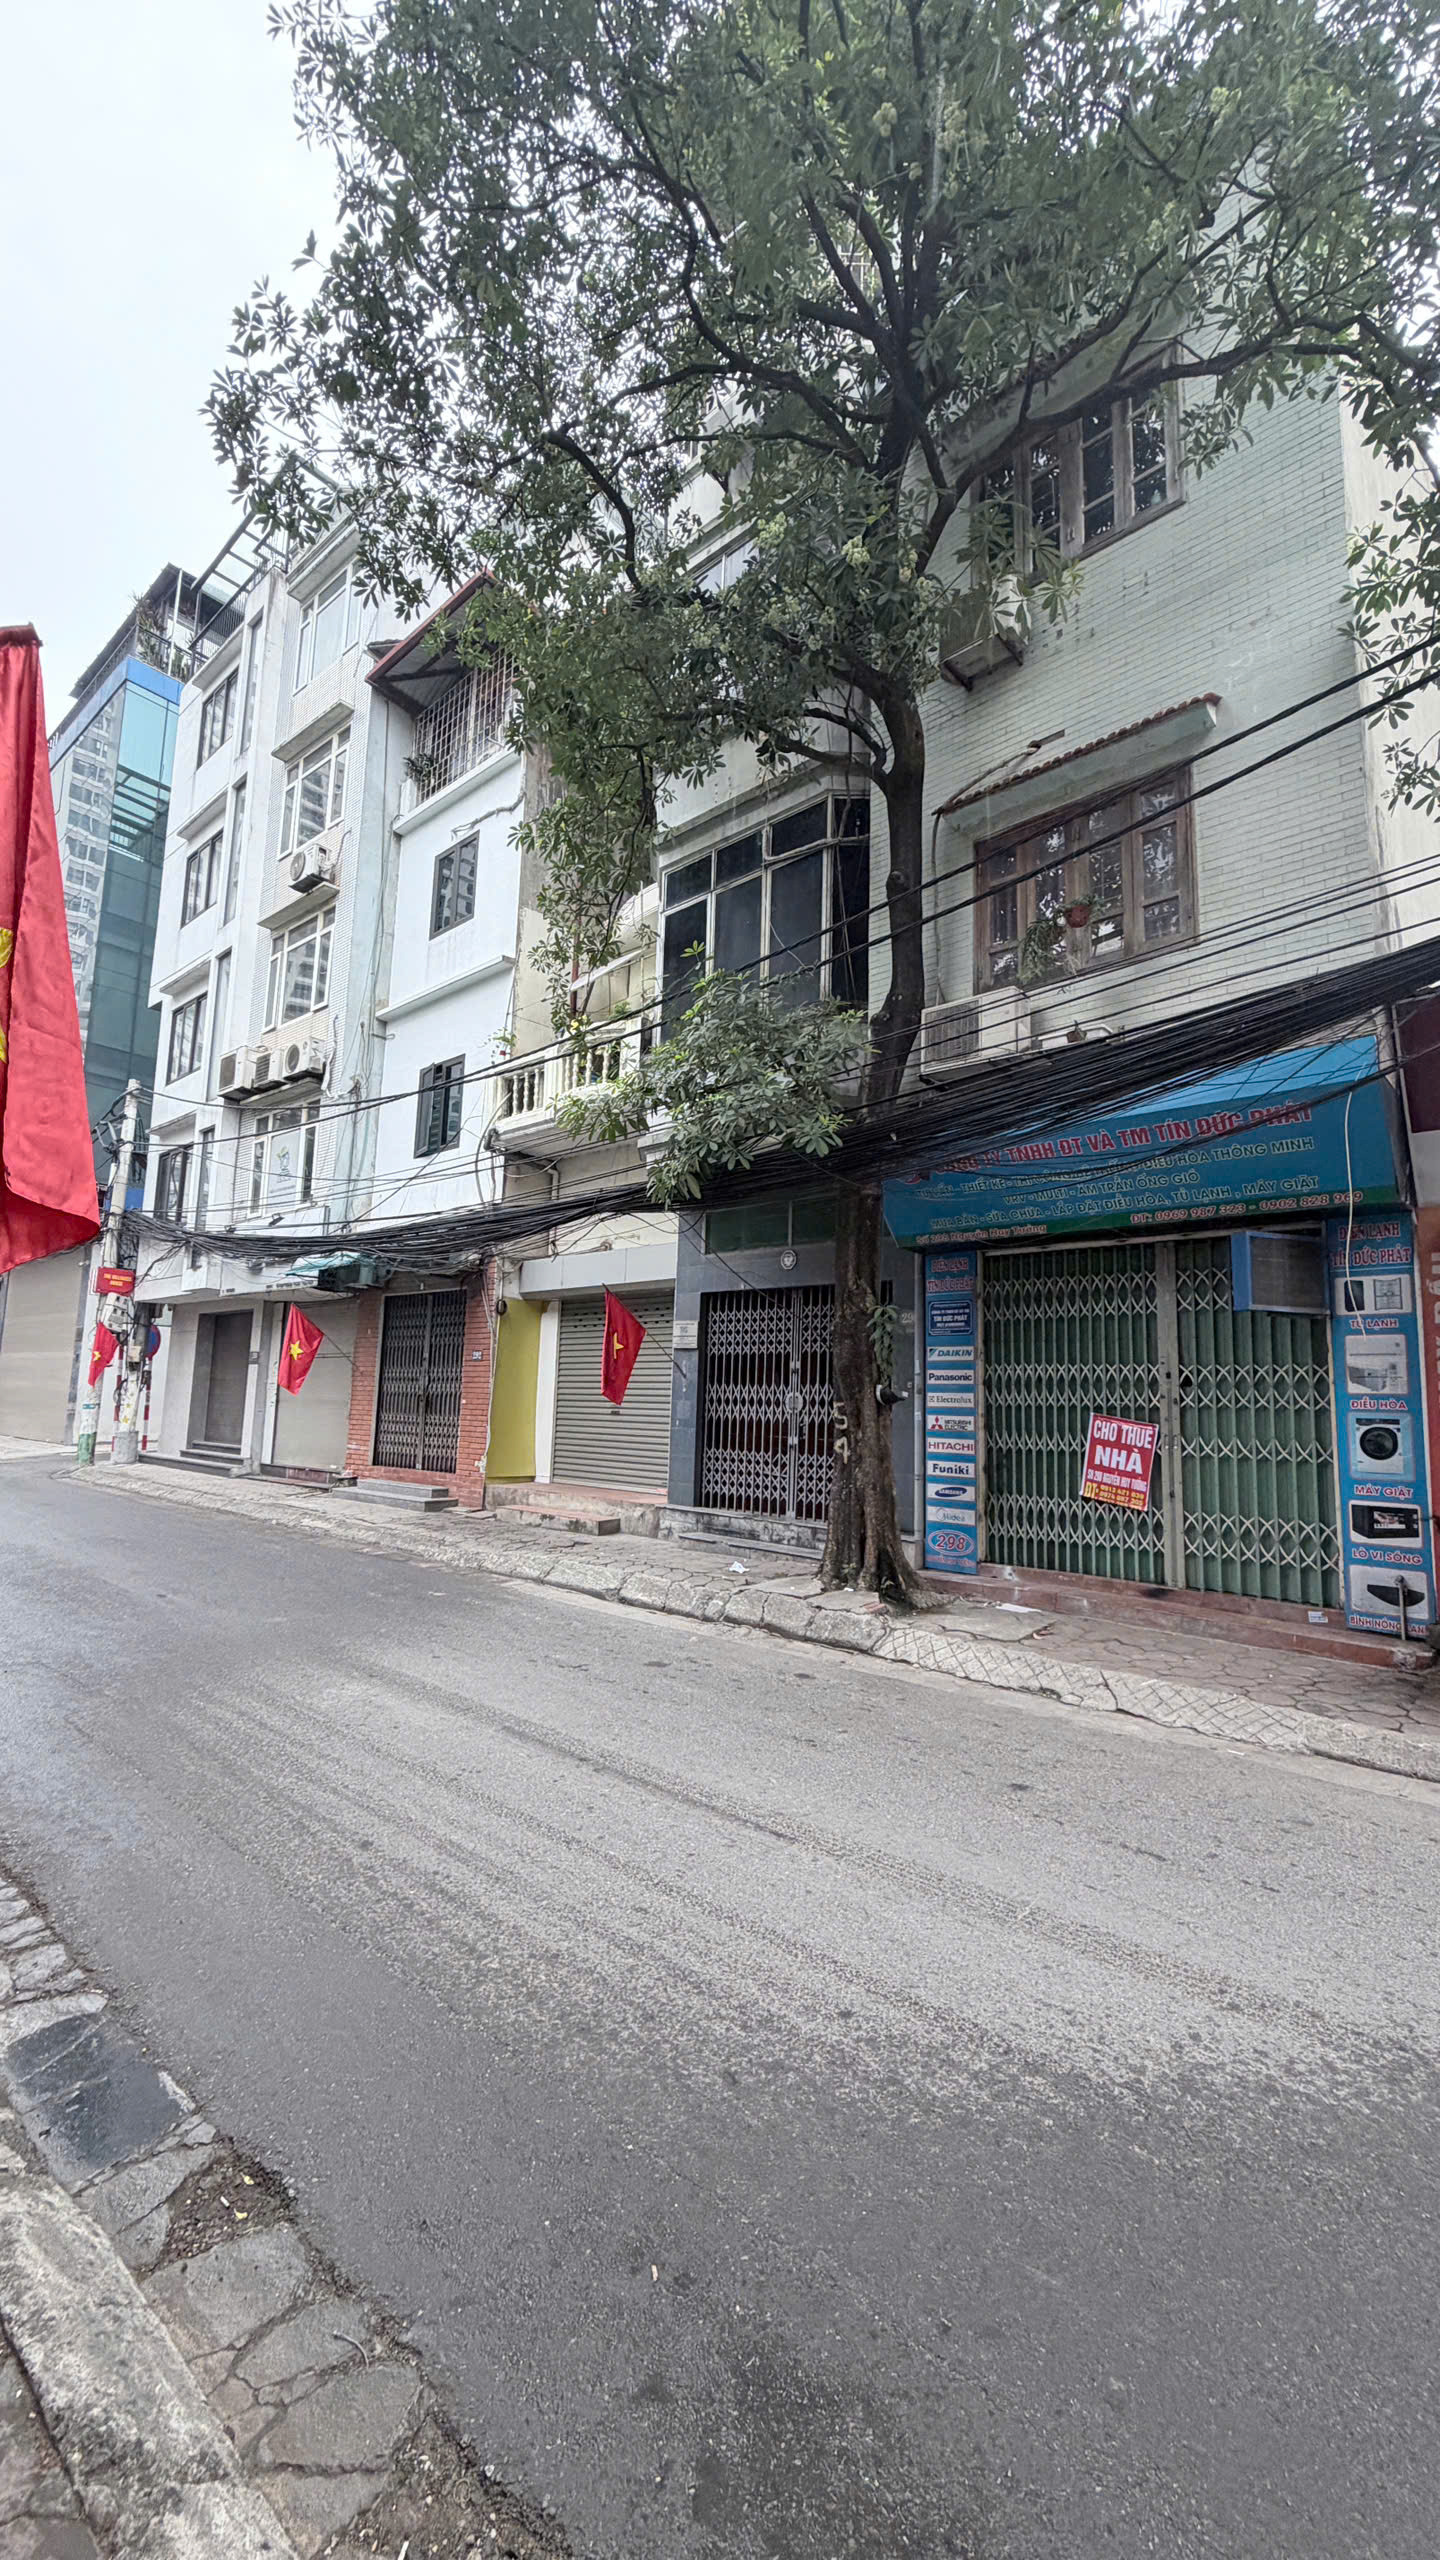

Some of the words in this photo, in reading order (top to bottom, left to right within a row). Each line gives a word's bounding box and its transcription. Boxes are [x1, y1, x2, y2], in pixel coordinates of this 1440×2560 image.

[1006, 1140, 1056, 1163] TNHH
[1057, 1135, 1085, 1158] ĐT
[1086, 1129, 1116, 1152] VÀ
[1117, 1126, 1151, 1149] TM
[1152, 1117, 1192, 1142] TÍN
[1195, 1110, 1242, 1138] ĐỨC
[1213, 1138, 1267, 1162] THÔNG
[1271, 1136, 1315, 1156] MINH
[1034, 1188, 1069, 1202] MULTI
[1135, 1172, 1168, 1190] ỐNG
[1103, 1192, 1133, 1210] ĐIỀU
[1171, 1187, 1191, 1203] TỦ
[1193, 1186, 1232, 1205] LẠNH
[1242, 1177, 1277, 1195] MÁY
[1281, 1175, 1319, 1191] GIẶT
[1154, 1208, 1189, 1222] 0969
[1190, 1205, 1216, 1218] 987
[1218, 1203, 1247, 1216] 323
[1258, 1198, 1298, 1211] 0902
[1300, 1194, 1330, 1208] 828
[1333, 1191, 1364, 1204] 969
[1367, 1221, 1401, 1242] LẠNH
[1352, 1245, 1377, 1266] ĐỨC
[1379, 1243, 1412, 1265] PHÁT
[1366, 1318, 1399, 1330] LẠNH
[937, 1348, 973, 1358] DAIKIN
[928, 1372, 973, 1382] Panasonic
[936, 1395, 973, 1405] Electrolux
[1351, 1396, 1377, 1410] ĐIỀU
[1379, 1398, 1408, 1411] HÒA
[944, 1424, 969, 1432] ELECTRIC
[1093, 1419, 1118, 1442] CHO
[928, 1441, 975, 1452] HITACHI
[1093, 1444, 1143, 1475] NHÀ
[932, 1463, 970, 1475] Funiki
[1354, 1483, 1381, 1496] MÁY
[1384, 1486, 1414, 1501] GIẶT
[943, 1511, 966, 1522] Midea
[936, 1534, 966, 1551] 298
[1352, 1546, 1369, 1559] LÒ
[1370, 1550, 1384, 1561] VI
[1386, 1550, 1423, 1566] SÓNG
[1350, 1614, 1373, 1627] BÌNH
[1374, 1617, 1402, 1631] NÓNG
